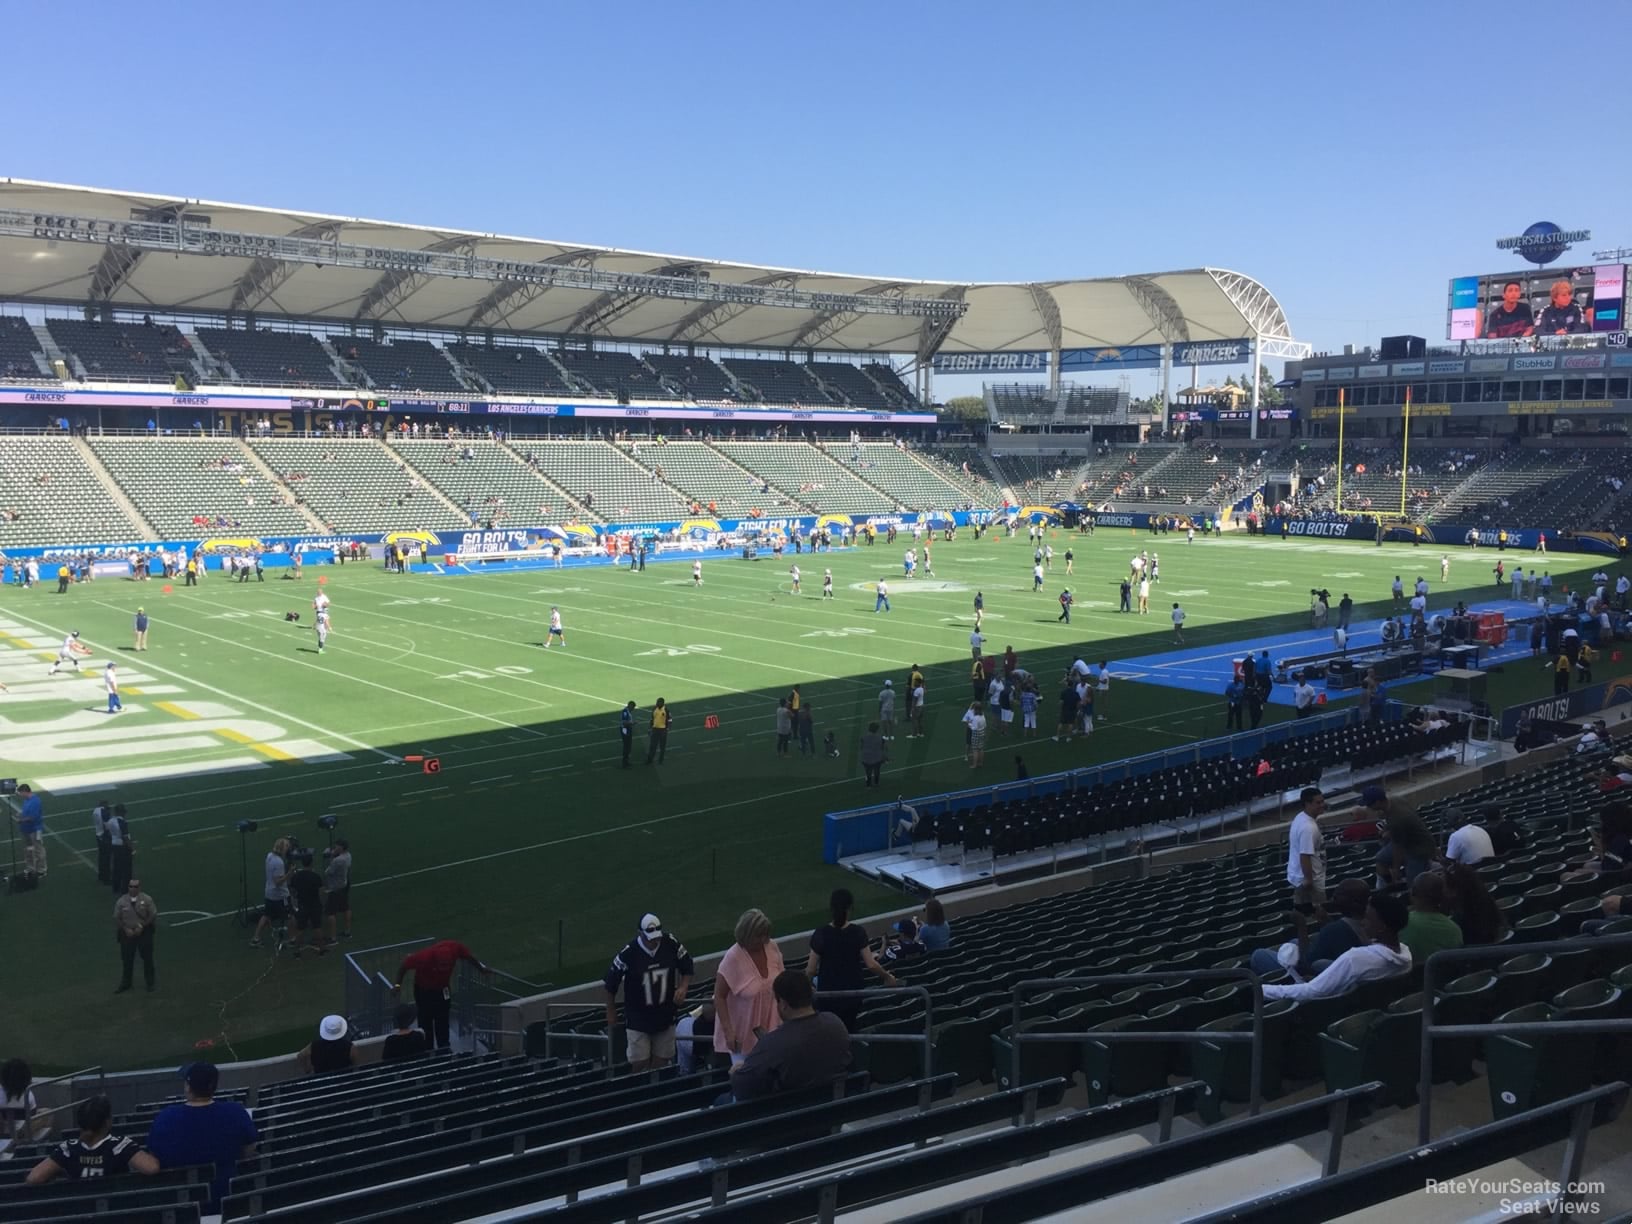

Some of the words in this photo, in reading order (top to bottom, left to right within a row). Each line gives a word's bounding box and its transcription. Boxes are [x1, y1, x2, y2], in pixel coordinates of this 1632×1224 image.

[1496, 235, 1547, 249] UNIVERSAL
[1548, 230, 1591, 243] STUDIOS
[1609, 334, 1625, 344] 40
[1181, 345, 1240, 363] CHARGERS
[941, 354, 987, 371] FIGHT
[989, 353, 1020, 370] FOR
[1022, 352, 1041, 368] LA
[1516, 359, 1553, 369] StubHub
[25, 393, 66, 402] CHARGERS
[172, 397, 209, 405] CHARGERS
[488, 404, 500, 413] LOS
[500, 404, 527, 413] ANGELES
[527, 404, 559, 414] CHARGERS
[218, 411, 294, 432] THIS
[1096, 515, 1133, 527] CHARGERS
[1289, 521, 1304, 534] GO
[1306, 521, 1349, 536] BOLTS!
[463, 532, 481, 545] GO
[484, 530, 527, 544] BOLTS!
[483, 543, 499, 552] FOR
[499, 542, 509, 552] LA
[650, 644, 722, 656] 20
[458, 665, 534, 680] 10
[1537, 698, 1569, 721] BOLTS!
[707, 716, 718, 728] 10
[426, 759, 439, 772] G
[642, 968, 670, 1006] 17
